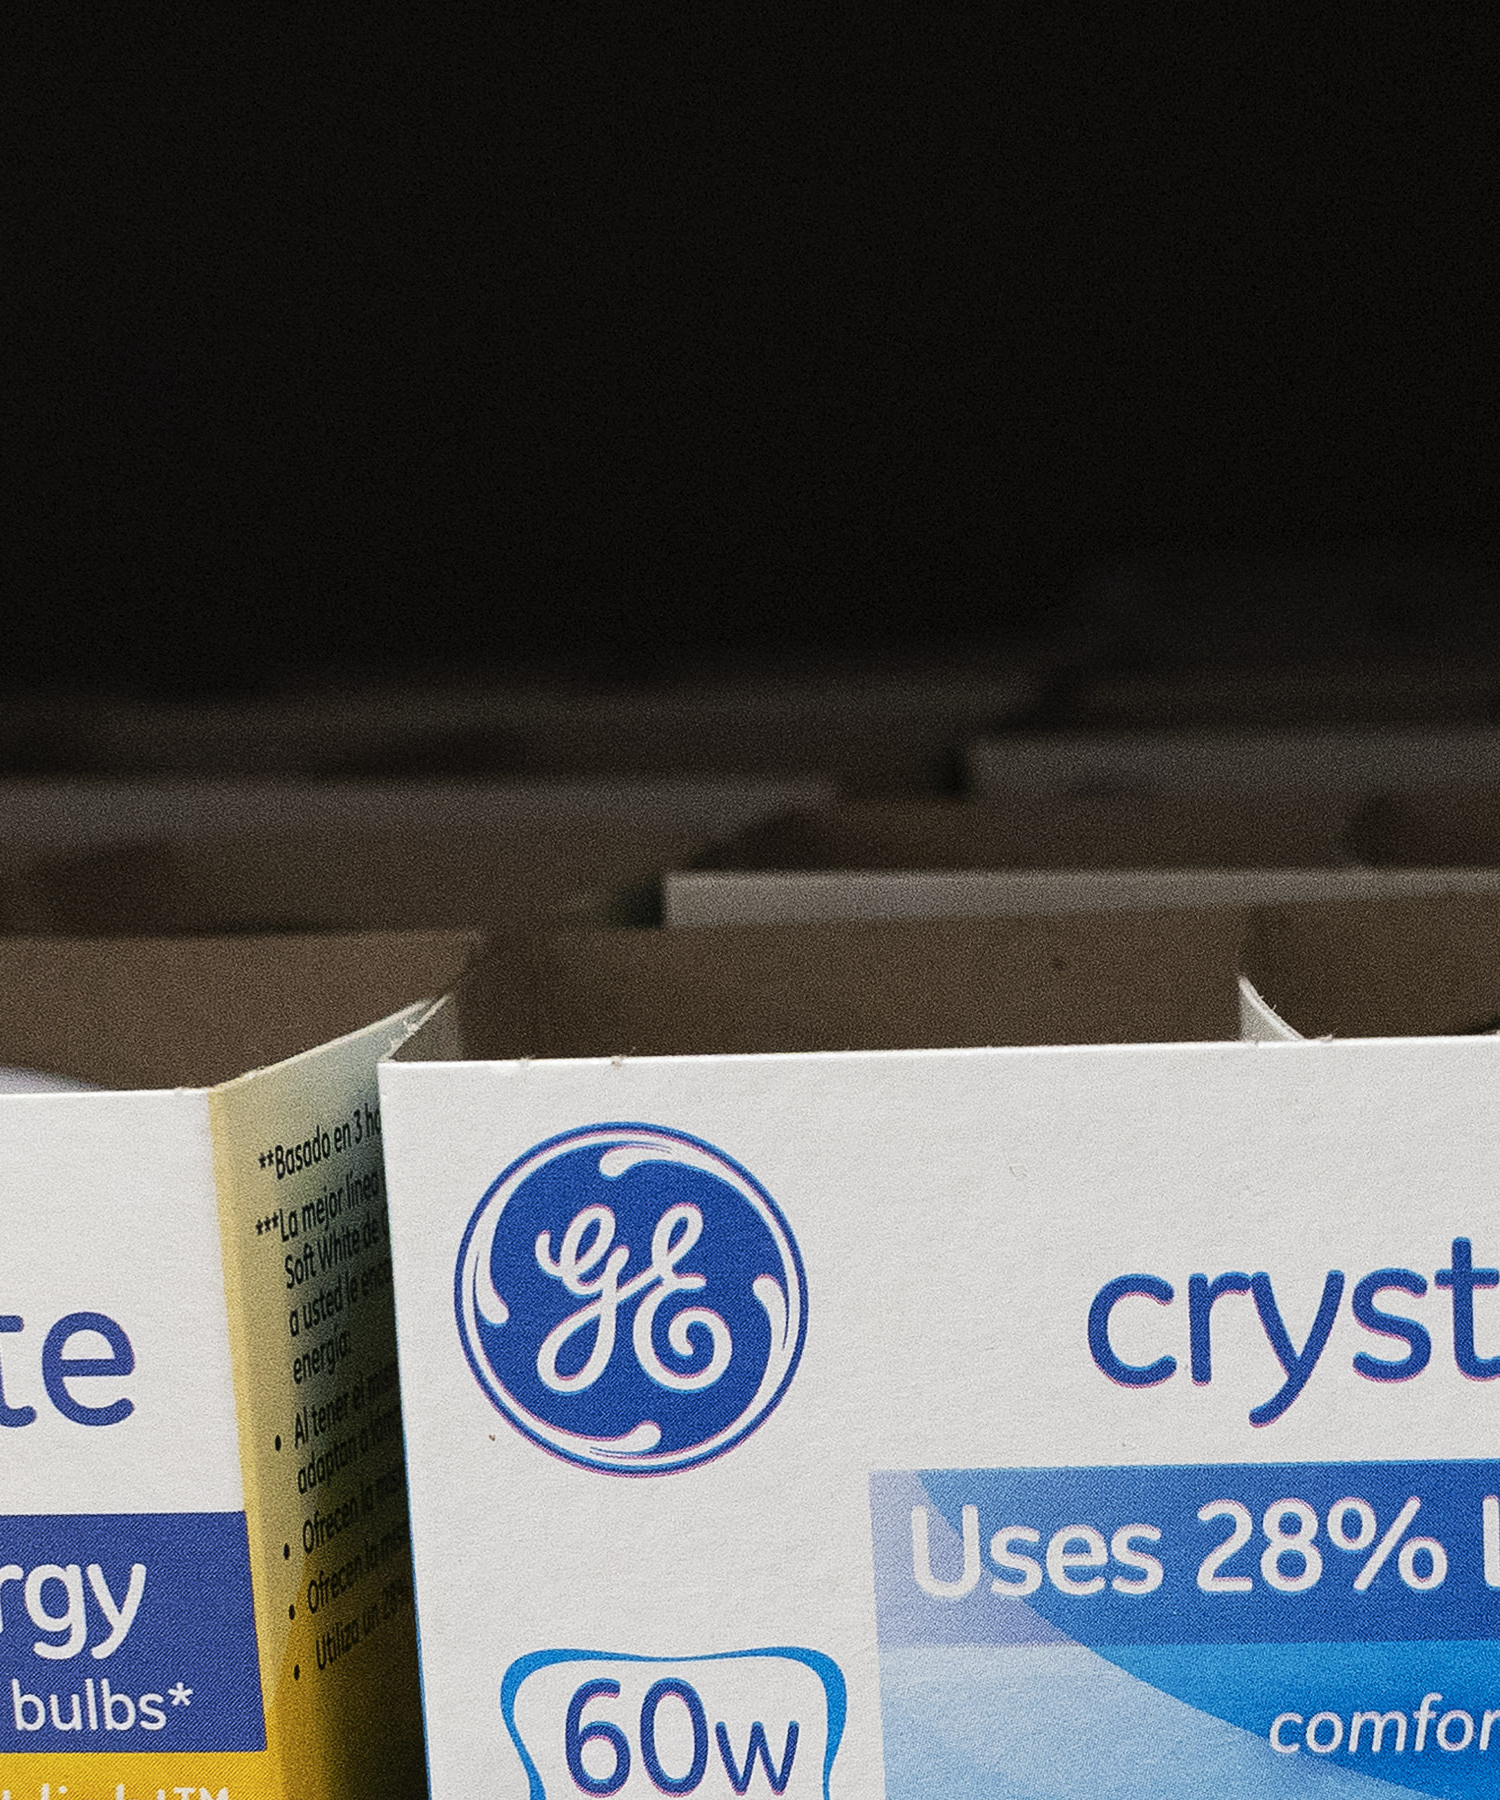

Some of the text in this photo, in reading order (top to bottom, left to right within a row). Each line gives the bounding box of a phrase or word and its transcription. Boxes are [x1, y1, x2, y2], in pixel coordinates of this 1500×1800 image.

[354, 1108, 363, 1143] 3
[301, 1188, 344, 1236] mejor
[285, 1228, 362, 1289] Soft White
[909, 1504, 1163, 1599] Uses
[1197, 1495, 1448, 1594] 28%
[565, 1678, 799, 1798] 60w
